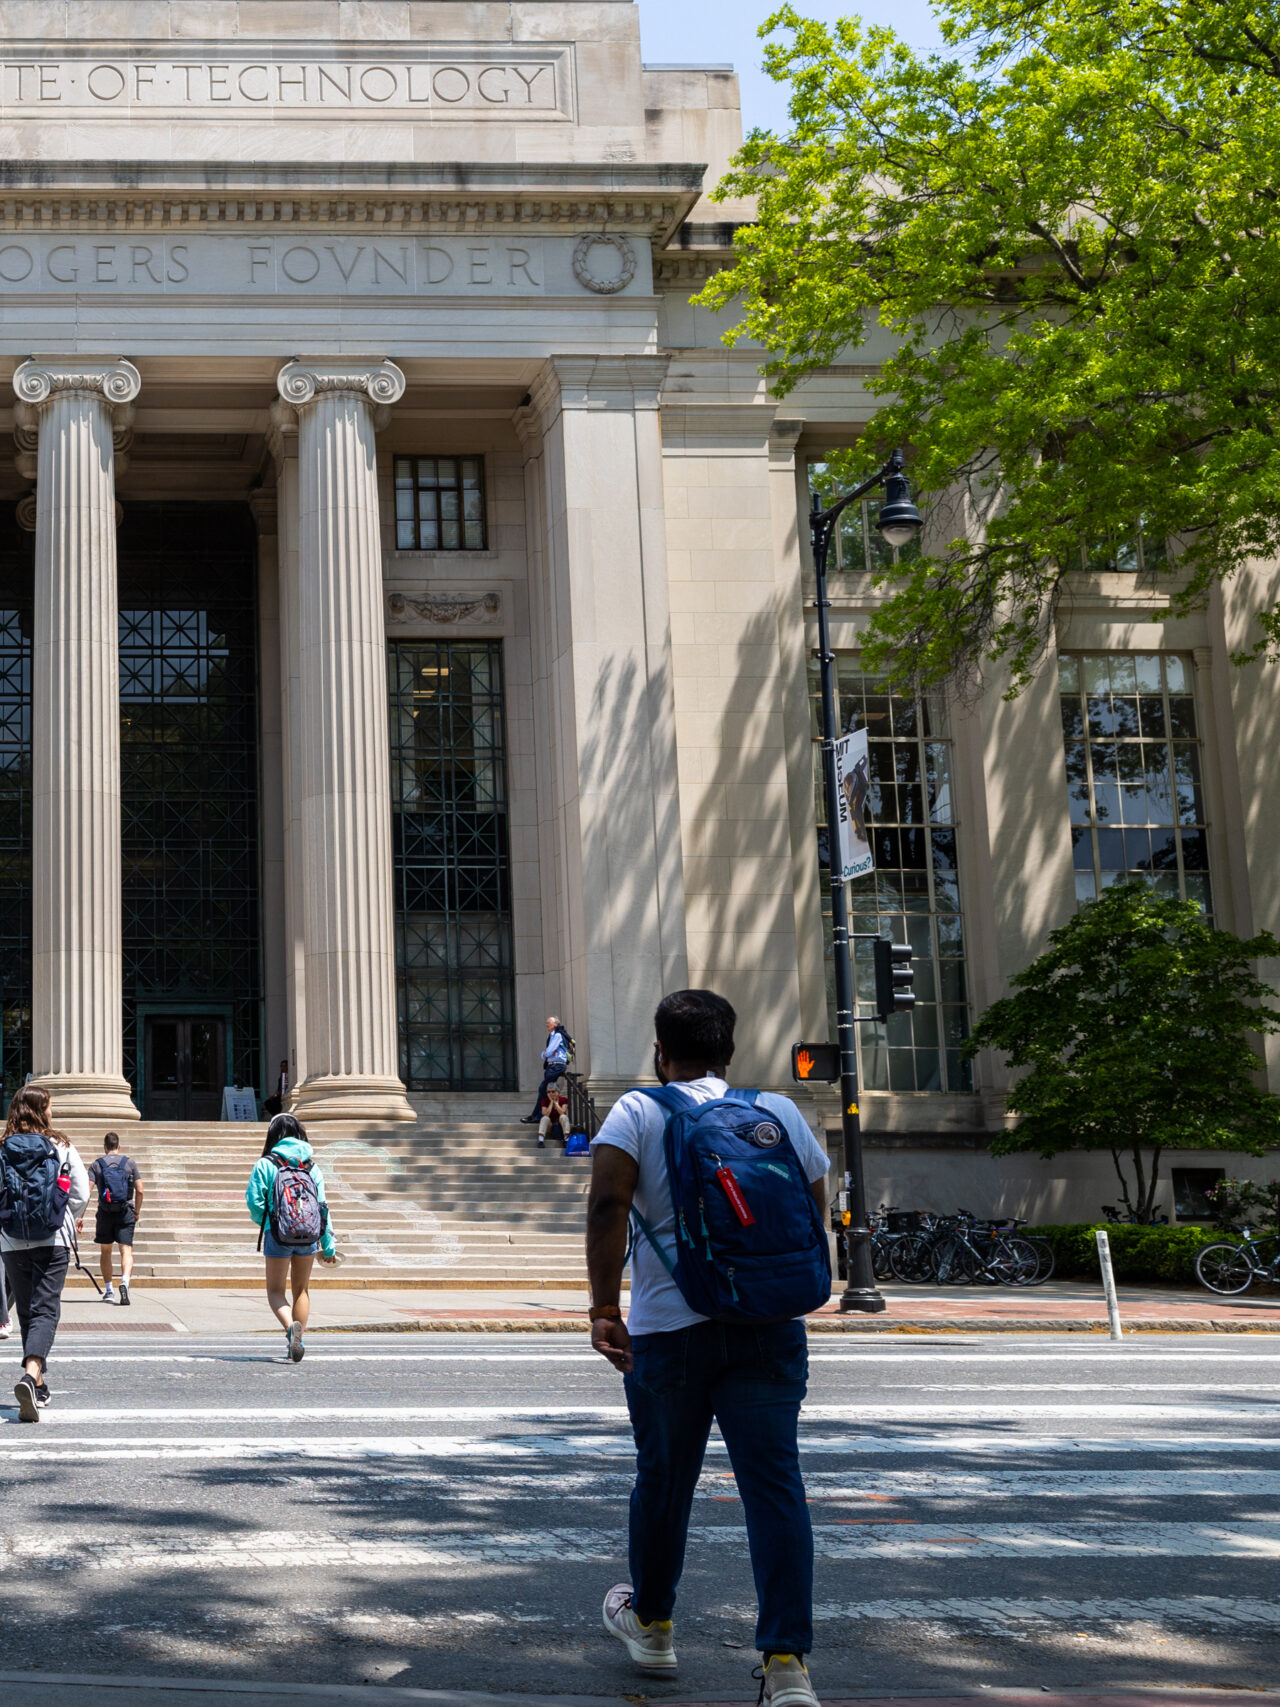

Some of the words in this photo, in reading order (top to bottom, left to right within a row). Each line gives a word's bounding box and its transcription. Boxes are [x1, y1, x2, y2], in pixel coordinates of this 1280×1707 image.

[87, 63, 159, 103] OF
[173, 63, 547, 104] TECHNOLOGY
[248, 246, 540, 286] FOVNDER
[835, 739, 850, 758] MIT
[843, 857, 871, 877] Curious?
